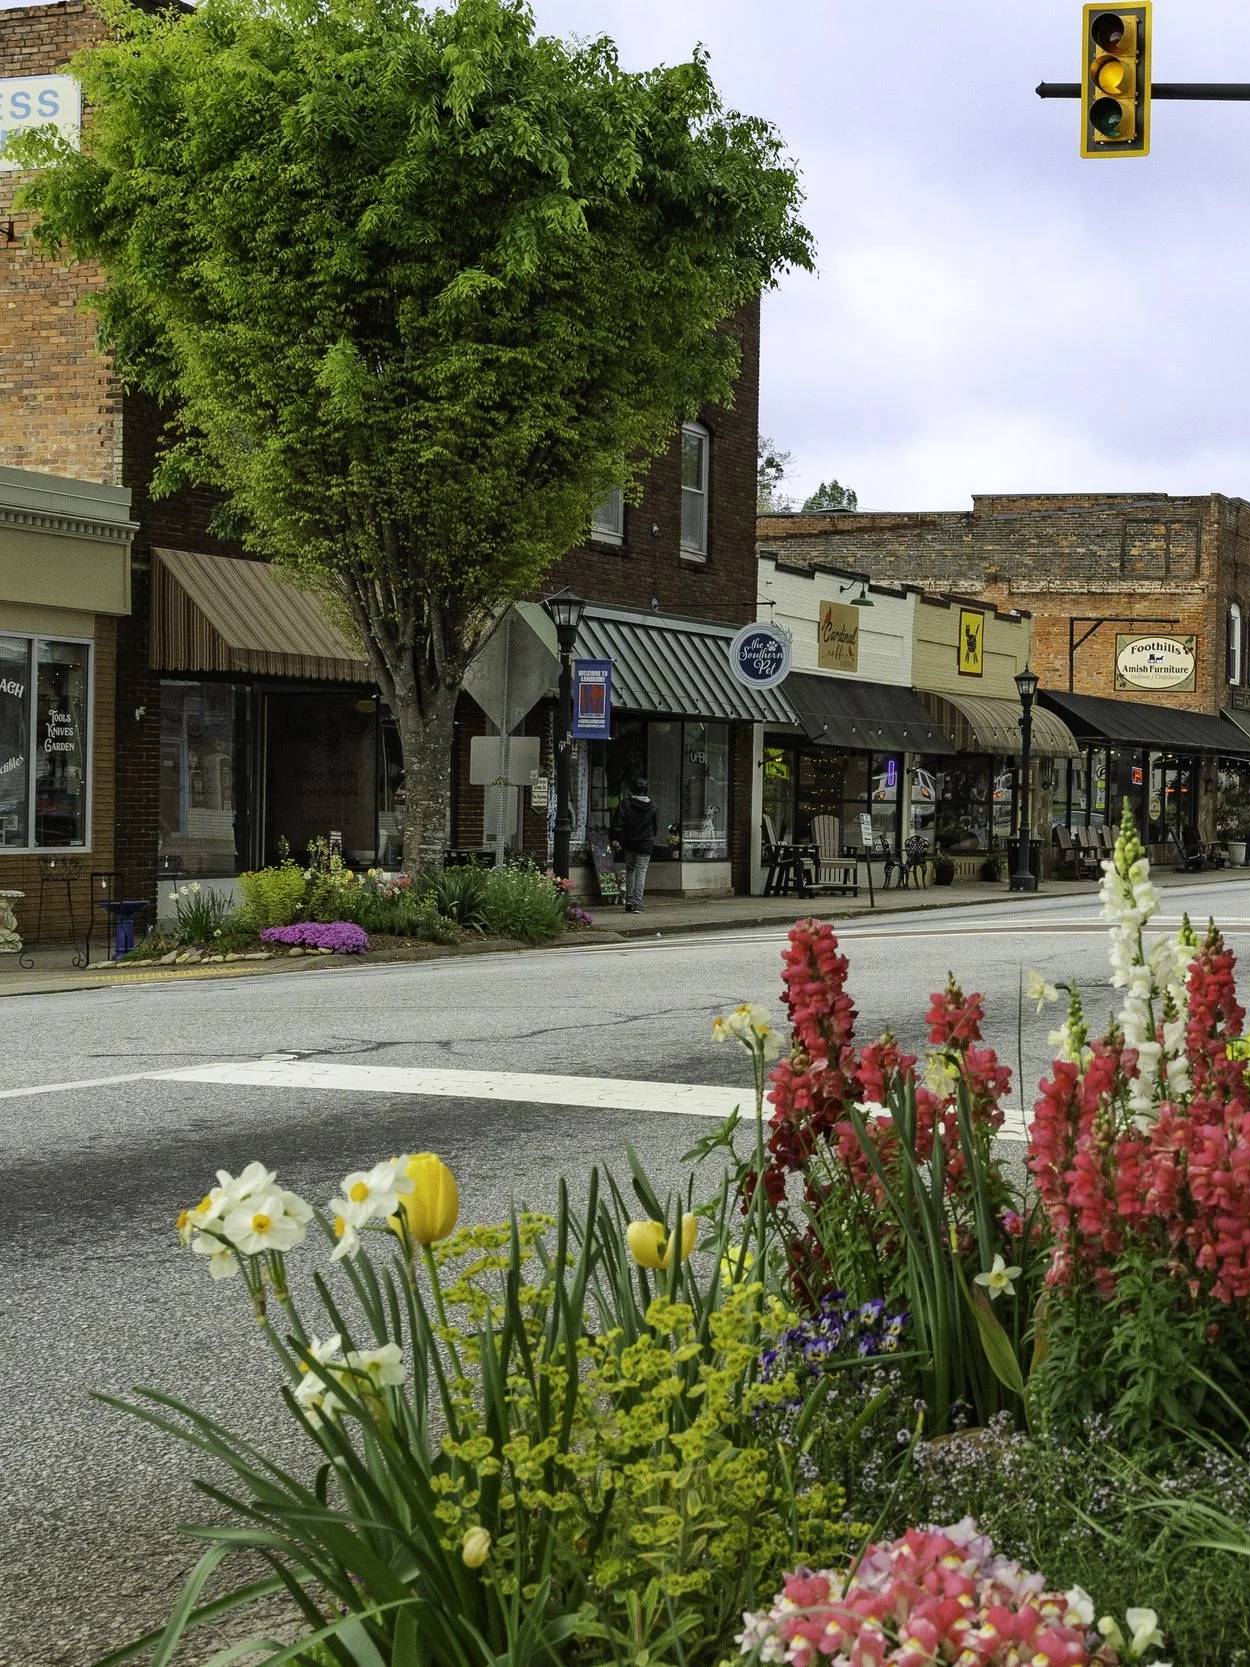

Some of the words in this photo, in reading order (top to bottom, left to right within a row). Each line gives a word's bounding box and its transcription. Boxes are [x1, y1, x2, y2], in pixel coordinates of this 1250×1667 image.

[0, 89, 59, 120] SS
[823, 621, 858, 645] Cardinal
[751, 637, 764, 651] the
[1131, 642, 1181, 655] Foothills
[738, 645, 783, 662] Southern
[753, 658, 777, 676] Pet
[1122, 664, 1148, 673] Amish
[1149, 664, 1189, 674] Furniture
